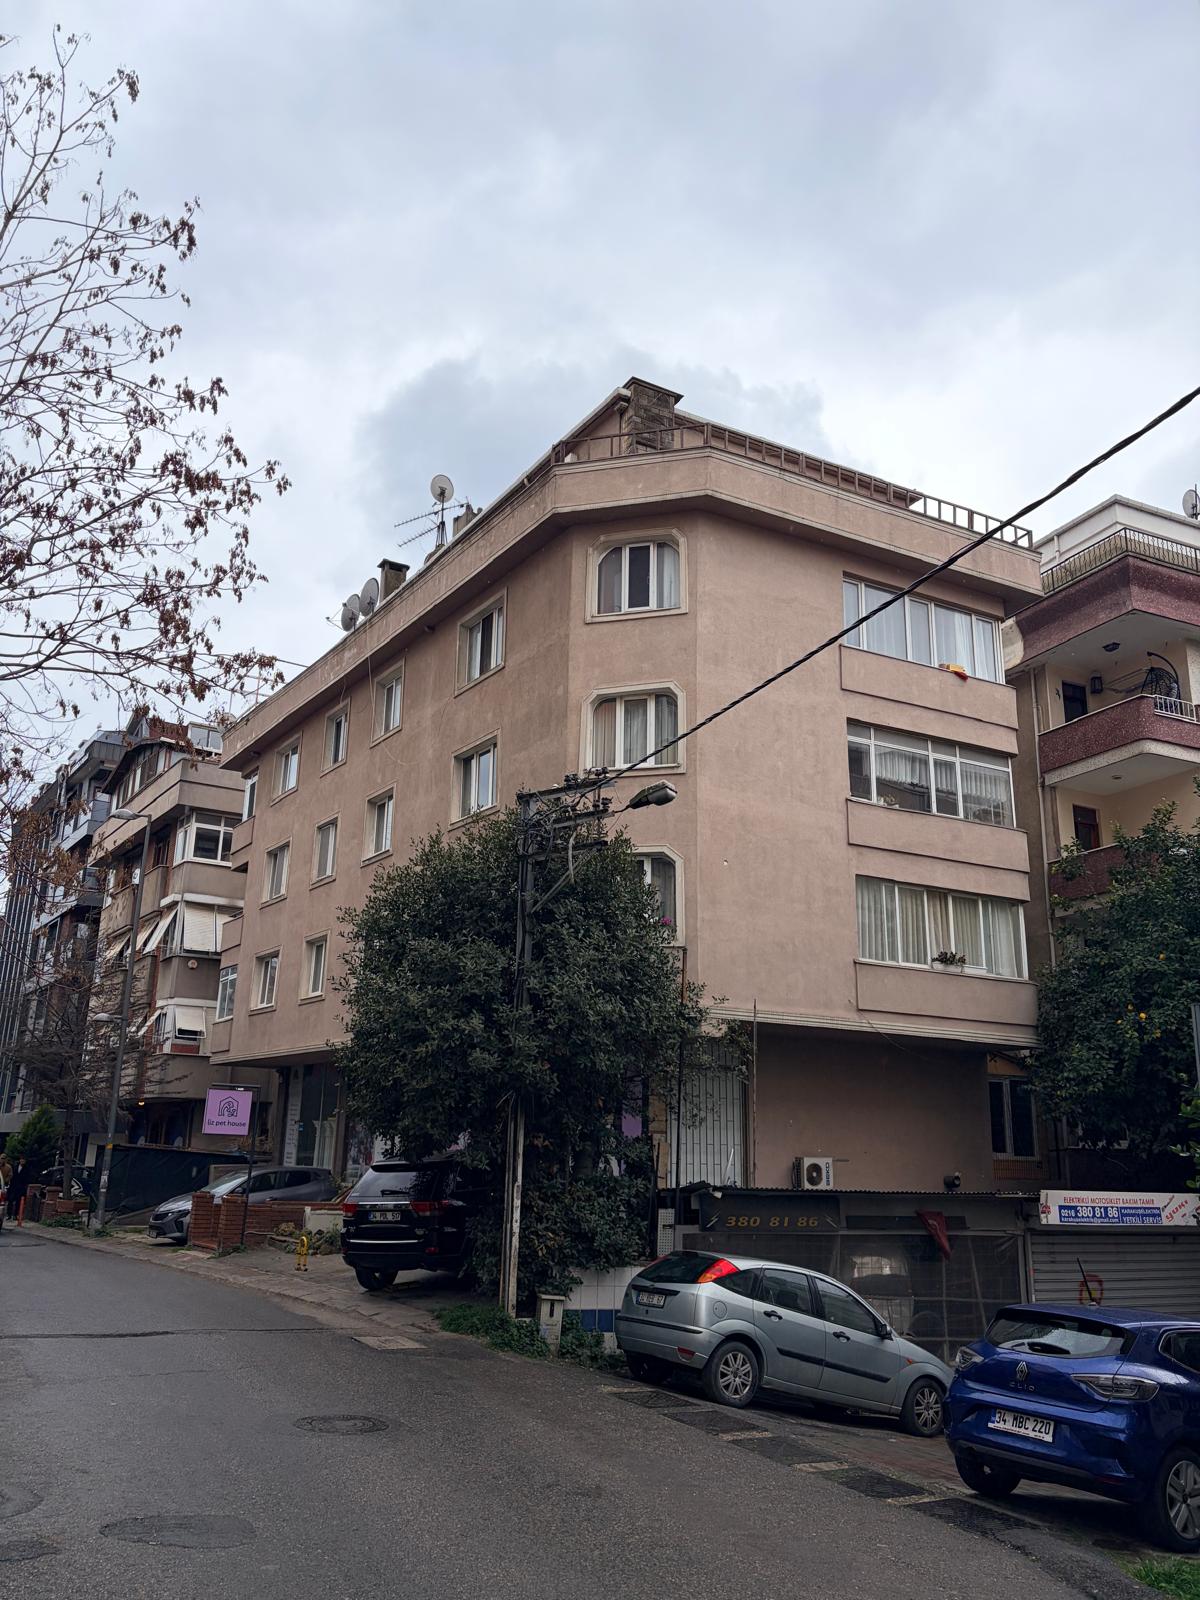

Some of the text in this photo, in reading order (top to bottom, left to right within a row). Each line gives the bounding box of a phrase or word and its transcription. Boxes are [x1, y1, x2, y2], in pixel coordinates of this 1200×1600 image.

[1060, 1206, 1119, 1218] 0216 380 81 86
[725, 1216, 818, 1227] 380 81 86
[995, 1410, 1007, 1426] 34
[1011, 1413, 1031, 1431] MBC
[1032, 1418, 1052, 1435] 220
